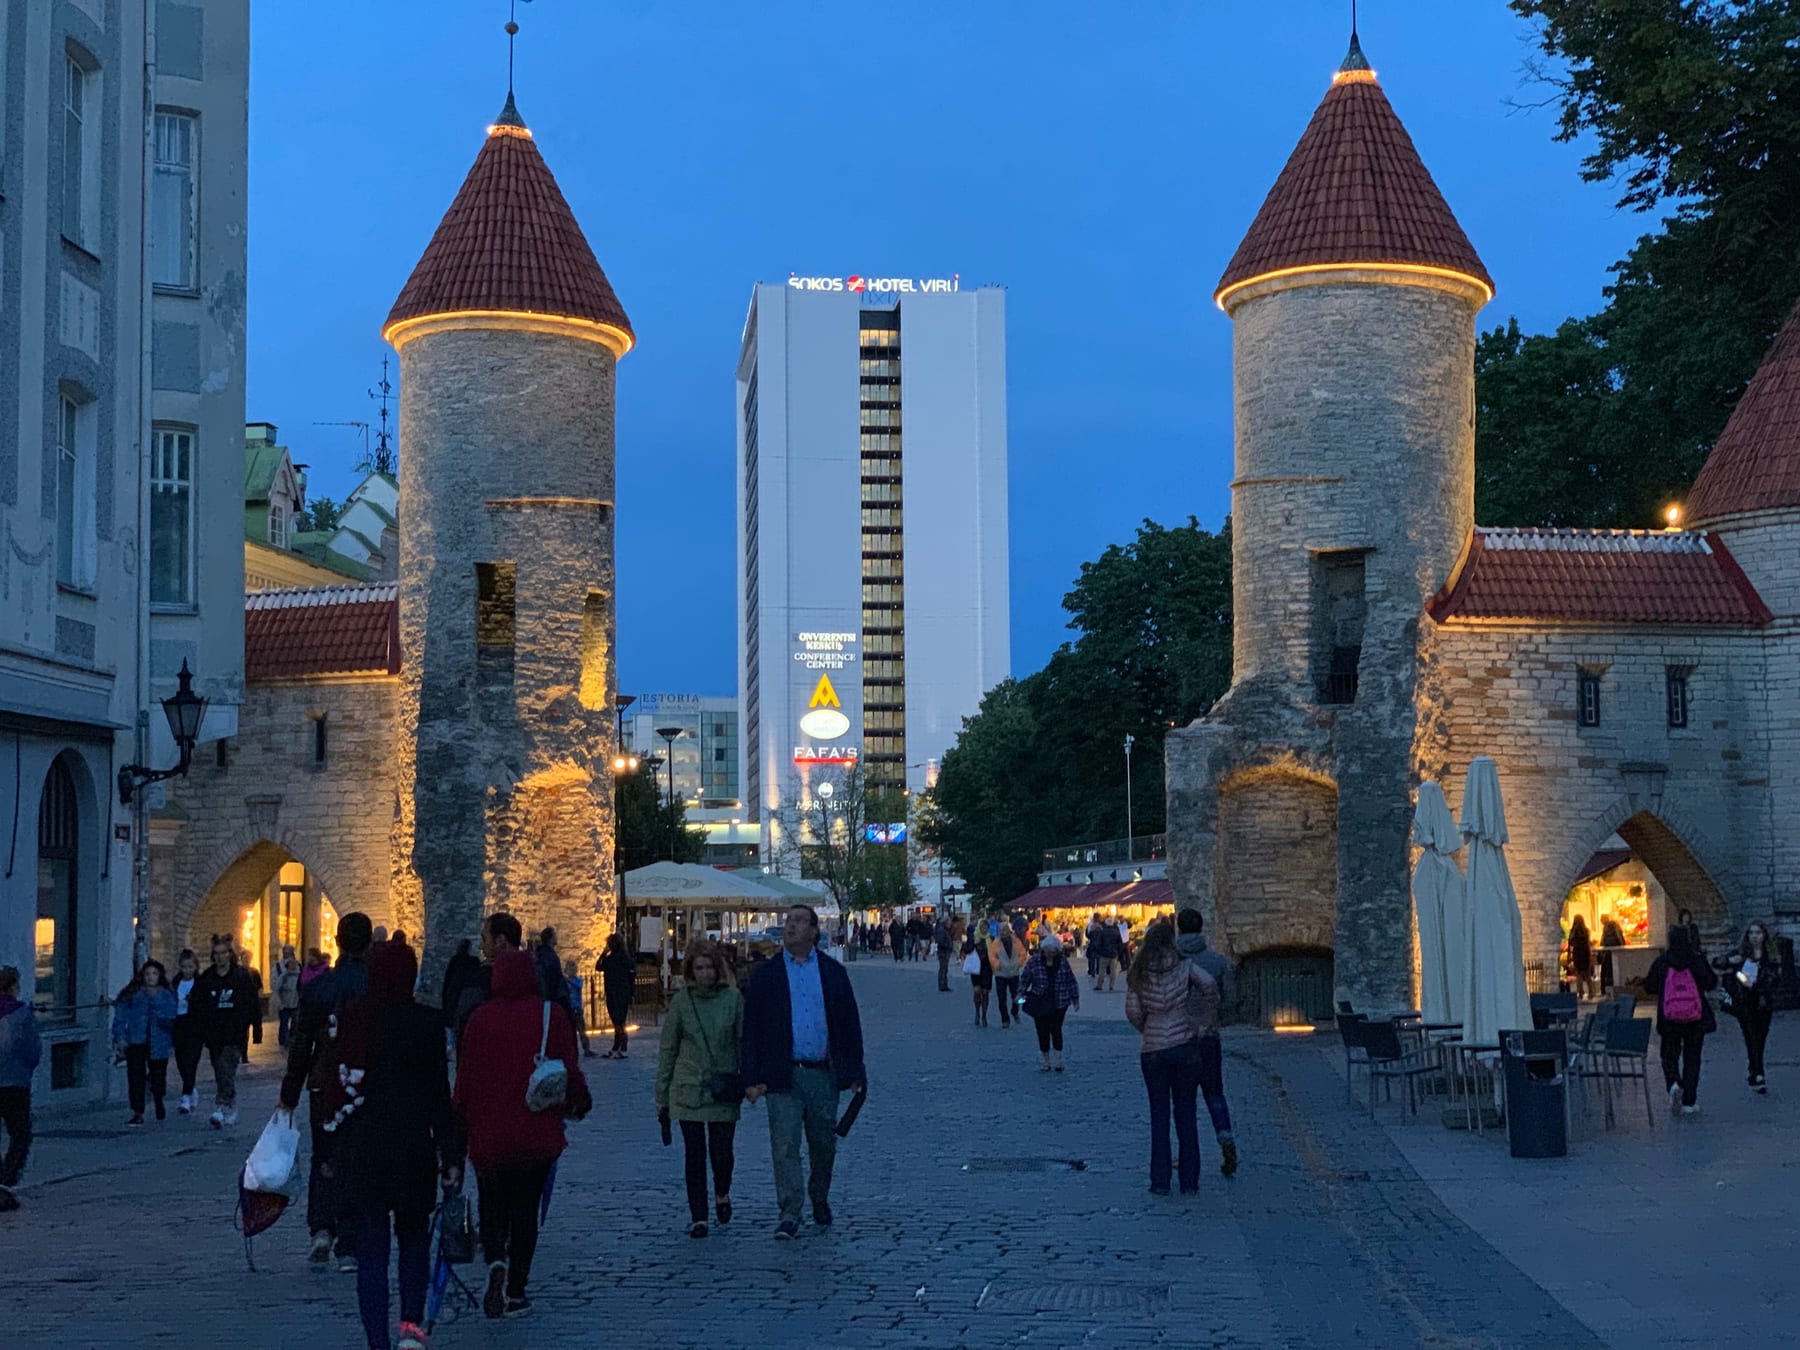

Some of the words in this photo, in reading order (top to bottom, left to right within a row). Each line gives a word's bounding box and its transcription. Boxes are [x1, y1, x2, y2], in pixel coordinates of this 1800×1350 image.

[868, 278, 918, 292] HOTEL
[794, 652, 856, 661] CONFERENCE
[806, 660, 844, 669] CENTER
[642, 694, 700, 703] ESTORIA
[794, 746, 858, 759] FAFA'S
